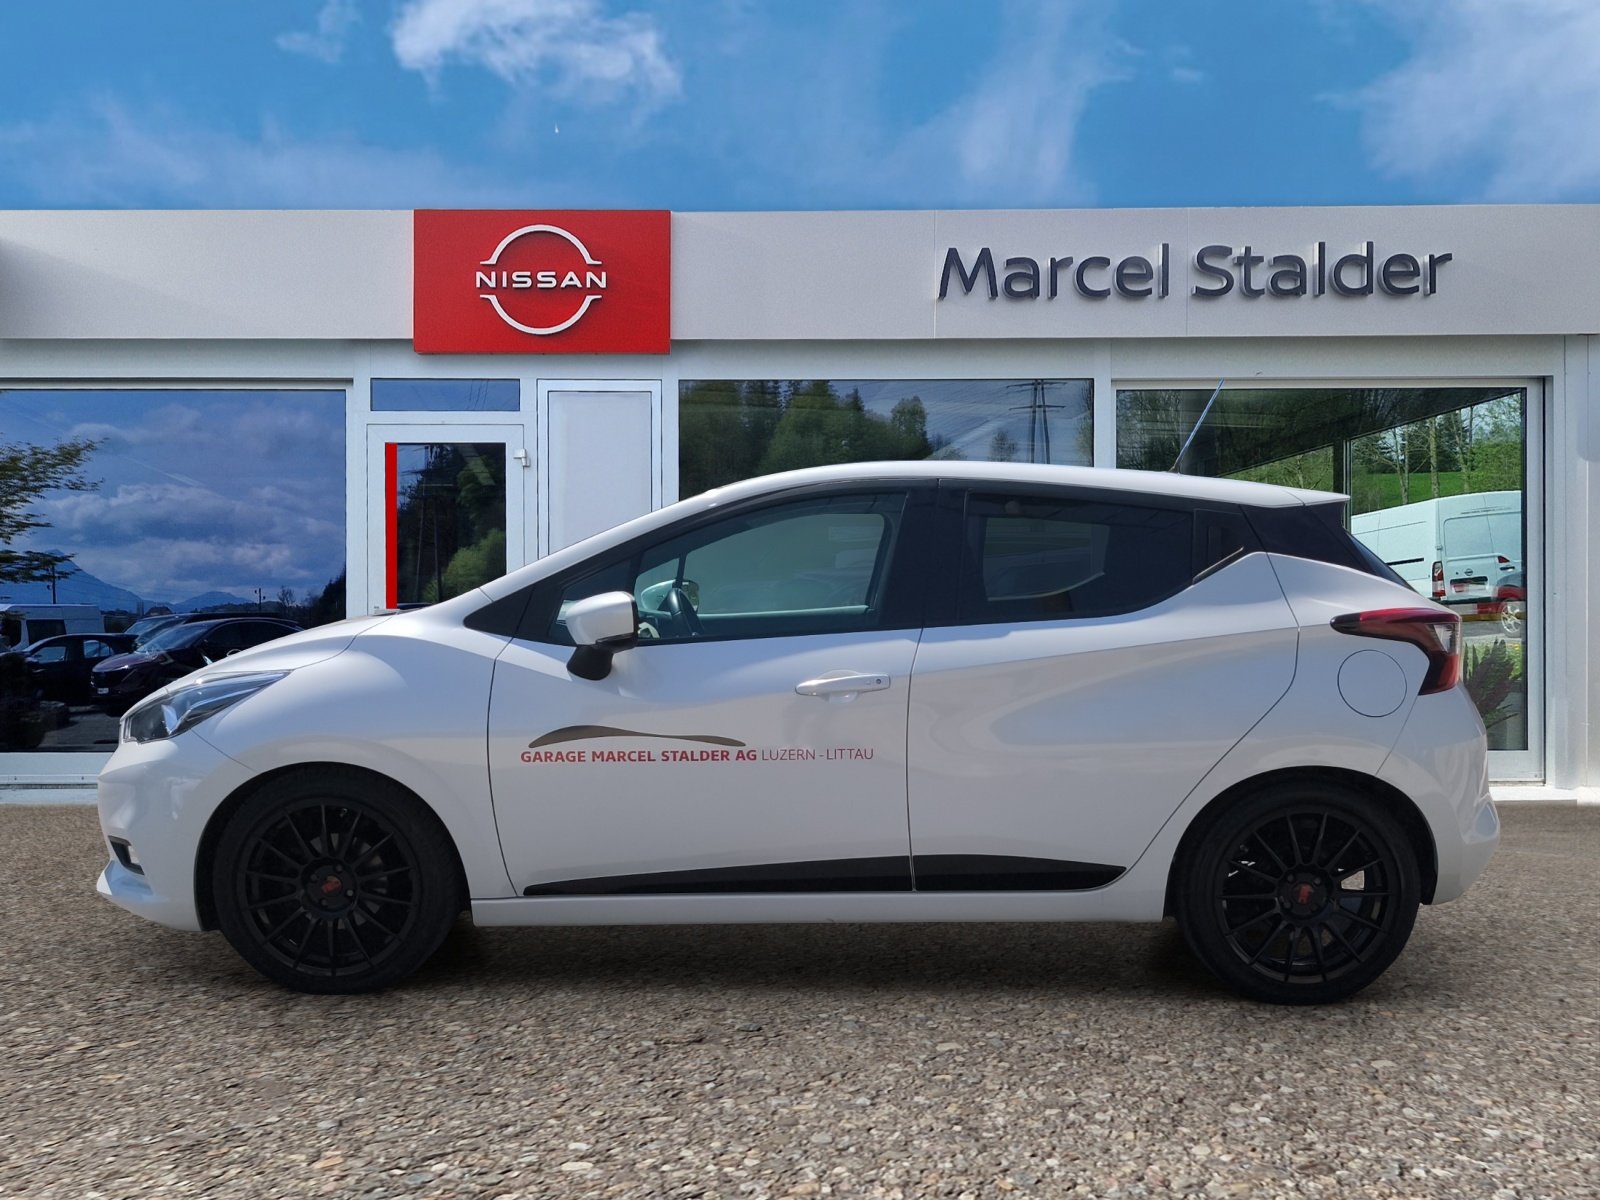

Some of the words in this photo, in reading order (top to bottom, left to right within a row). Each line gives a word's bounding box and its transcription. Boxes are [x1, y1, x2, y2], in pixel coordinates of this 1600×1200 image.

[938, 243, 1169, 300] Marcel
[1192, 241, 1453, 298] Stalder
[475, 271, 607, 289] NISSAN
[520, 750, 586, 763] GARAGE
[591, 750, 657, 763] MARCEL
[661, 750, 731, 762] STALDER
[735, 749, 757, 762] AG
[761, 748, 816, 761] LUZERN
[826, 748, 874, 760] LITTAU
